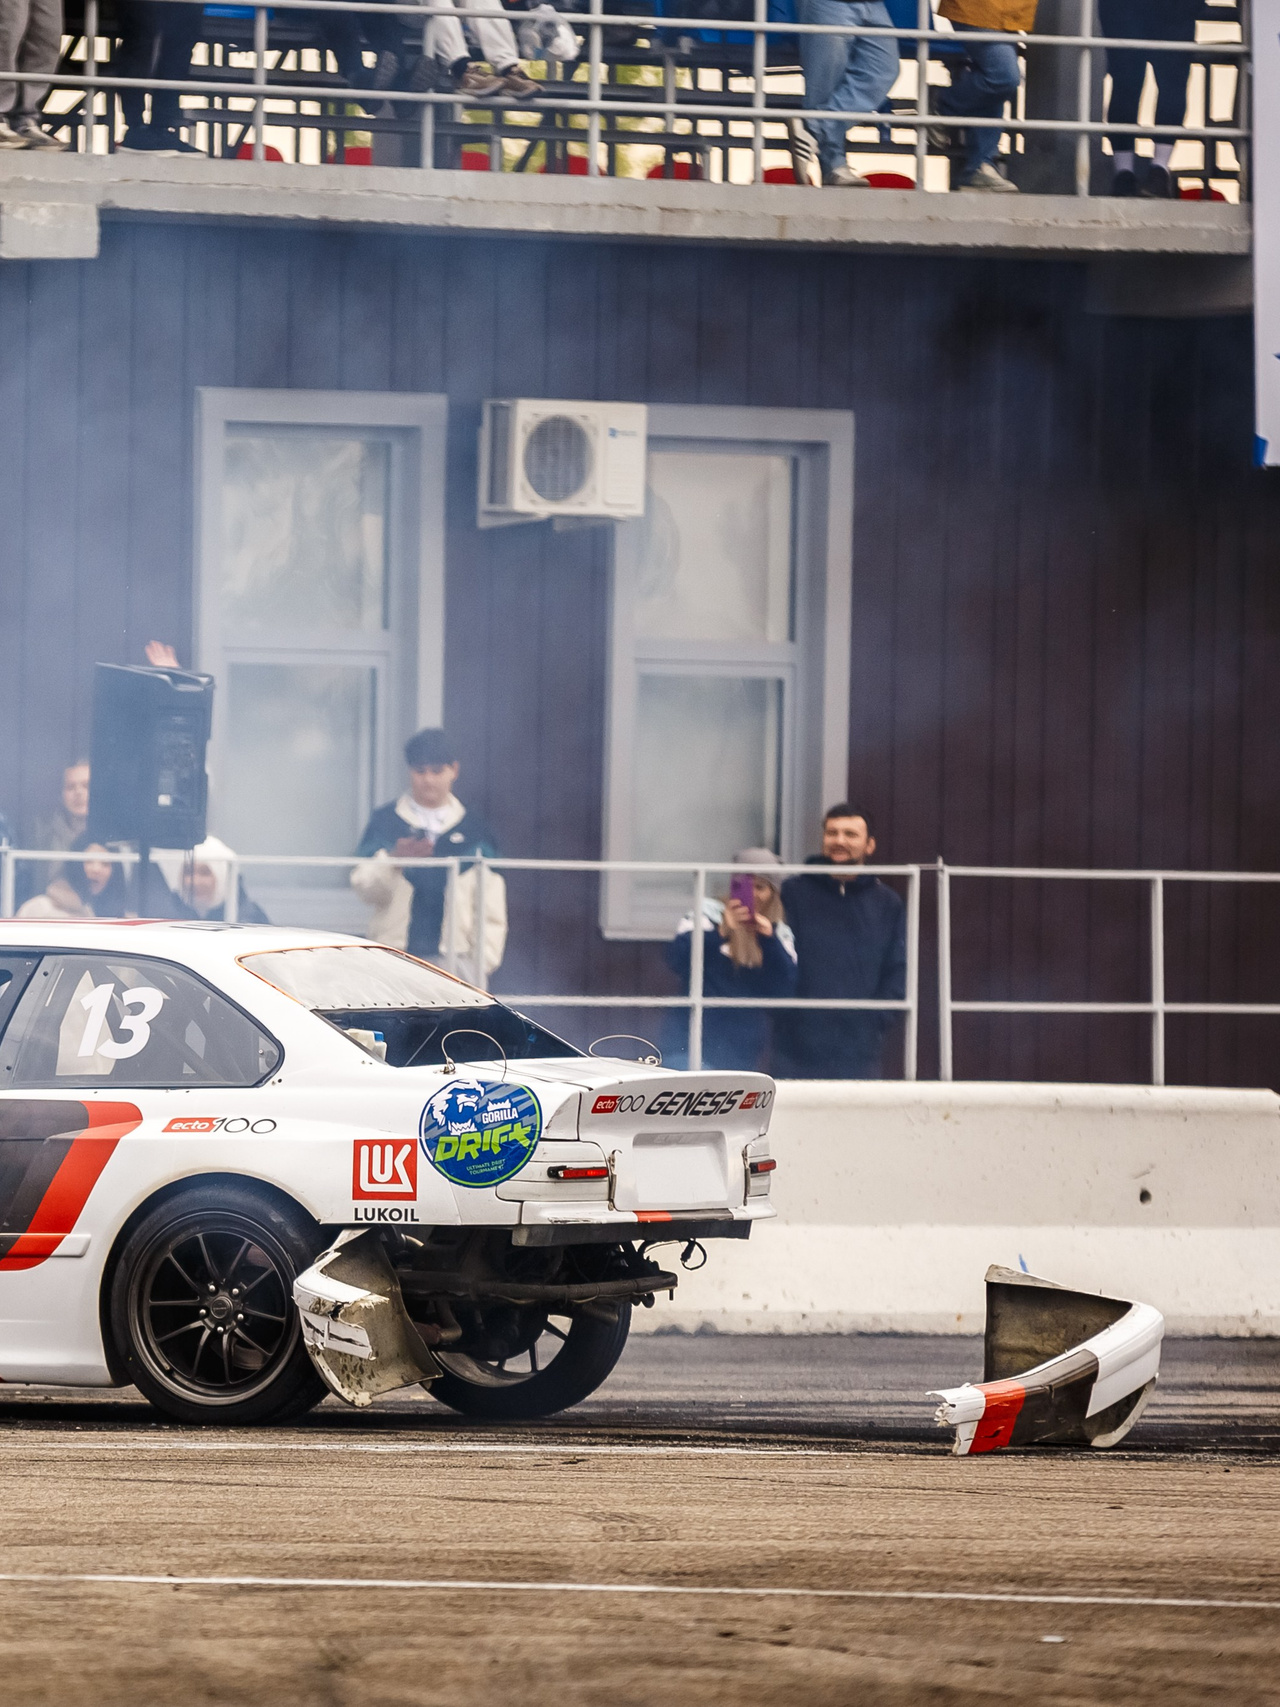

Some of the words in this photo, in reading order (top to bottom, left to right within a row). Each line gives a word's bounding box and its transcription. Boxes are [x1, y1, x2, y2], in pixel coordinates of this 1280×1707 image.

[77, 983, 164, 1060] 13
[482, 1108, 519, 1124] GORILLA
[645, 1090, 745, 1116] GENESIS
[360, 1144, 414, 1193] LUK
[354, 1207, 420, 1222] LUKOIL
